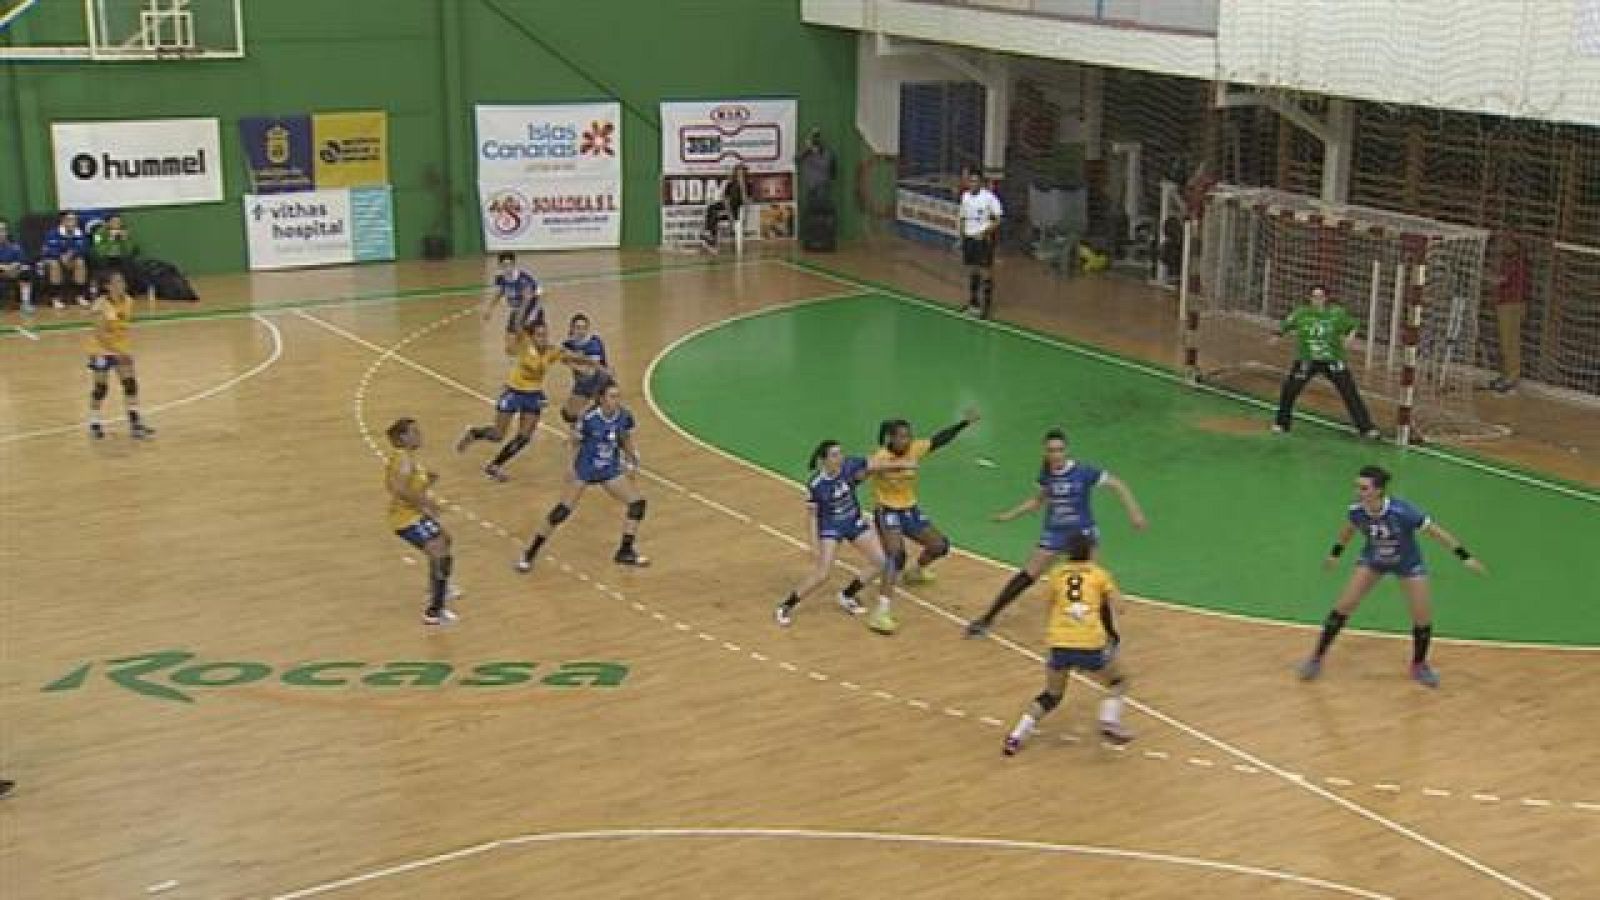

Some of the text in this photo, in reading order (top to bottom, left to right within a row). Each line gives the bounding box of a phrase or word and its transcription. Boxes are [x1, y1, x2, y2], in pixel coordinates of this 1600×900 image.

[527, 121, 577, 141] Islas
[482, 139, 578, 160] Canarias
[103, 148, 206, 181] hummel
[270, 202, 328, 219] vithas
[271, 219, 344, 241] hospital
[1066, 573, 1084, 602] 8
[40, 649, 630, 704] Rocasa
